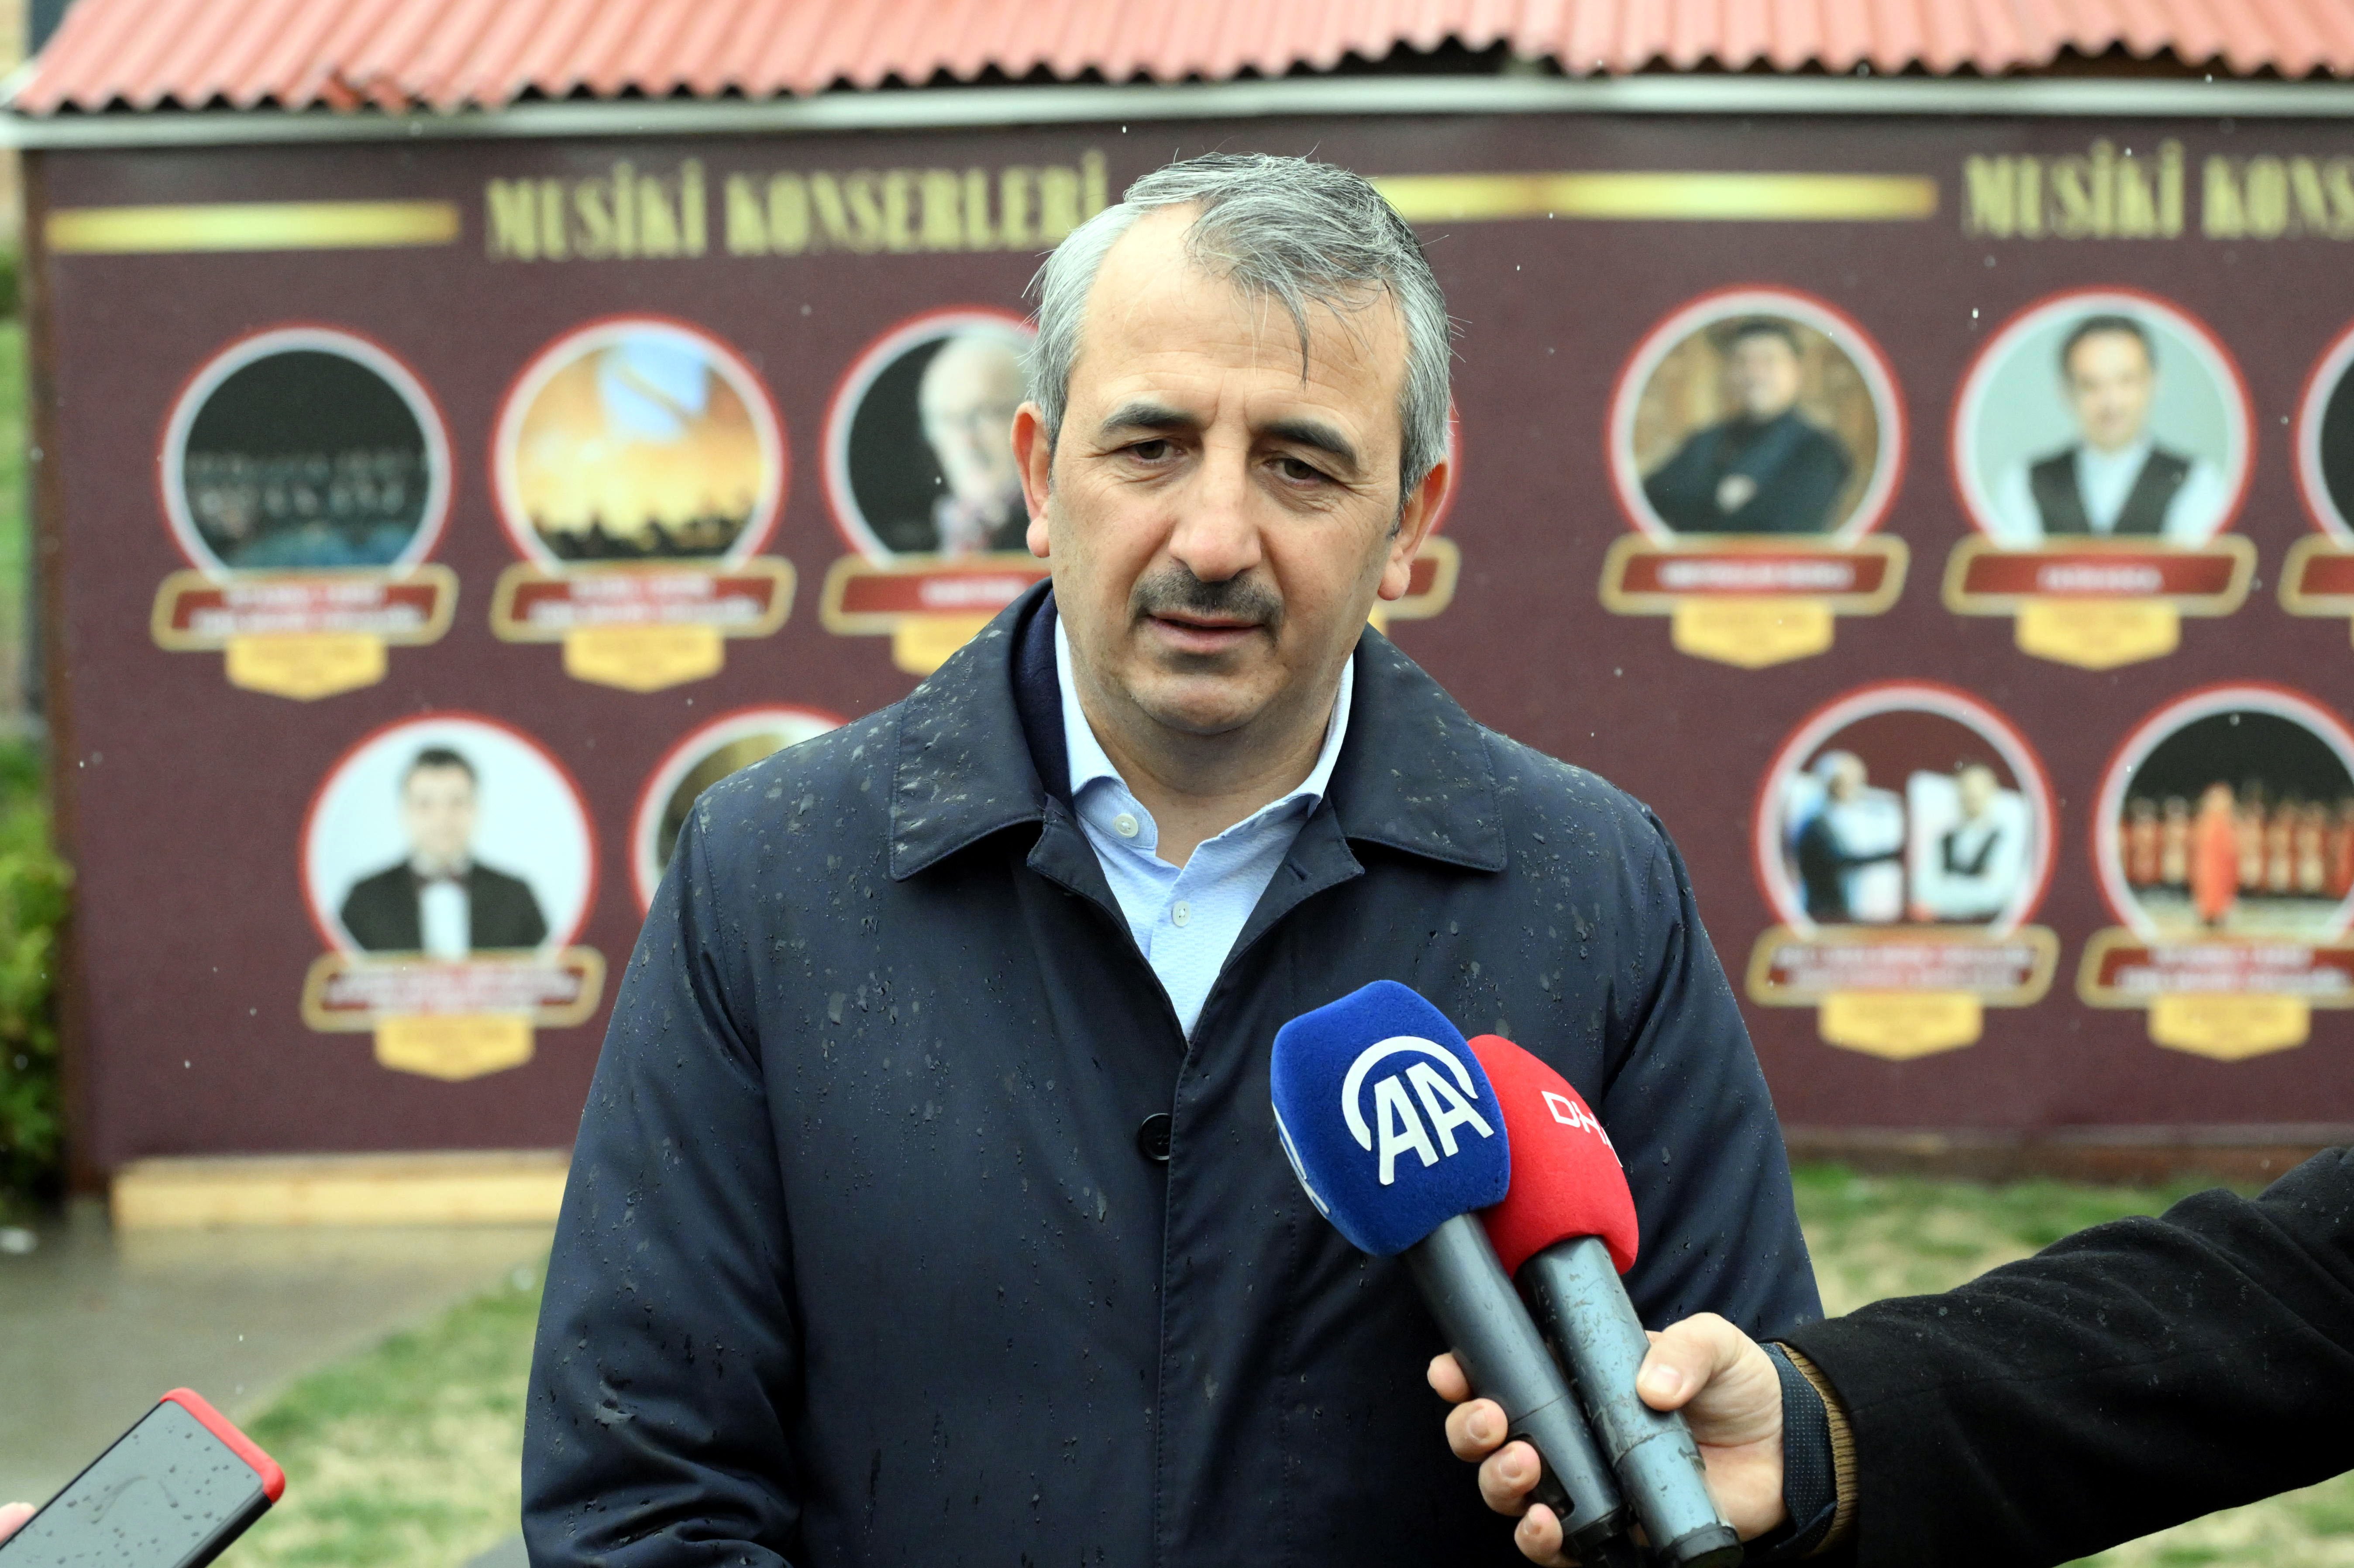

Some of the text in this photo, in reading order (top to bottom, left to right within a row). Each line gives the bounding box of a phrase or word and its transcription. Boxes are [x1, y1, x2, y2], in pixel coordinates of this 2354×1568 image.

[486, 157, 708, 261] MUSİKİ
[1963, 138, 2184, 240] MUSİKİ
[1374, 1062, 1494, 1185] AA
